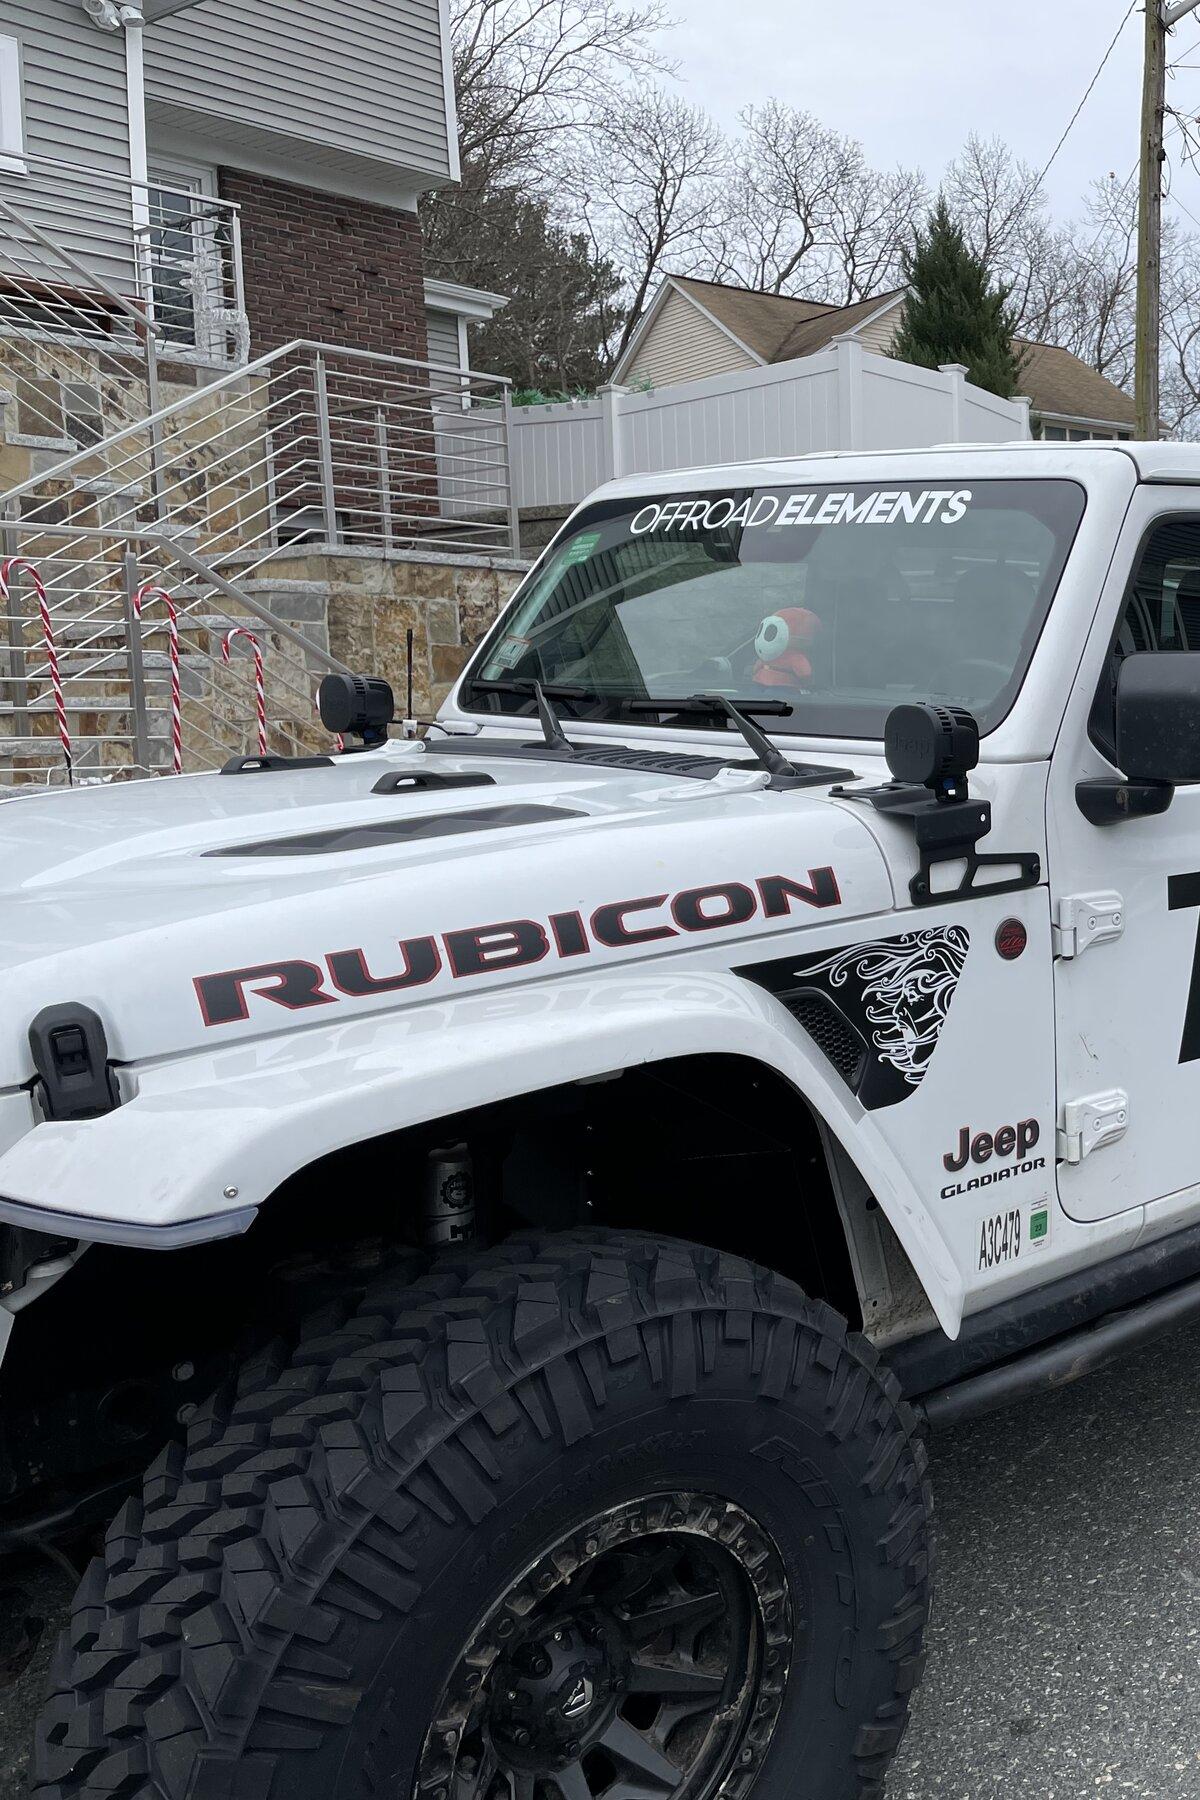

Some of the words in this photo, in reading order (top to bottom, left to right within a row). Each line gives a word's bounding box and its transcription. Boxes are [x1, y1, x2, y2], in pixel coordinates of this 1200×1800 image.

[192, 866, 842, 1028] RUBICON
[943, 1117, 1040, 1172] Jeep
[940, 1157, 1046, 1200] GLADIATOR
[979, 1209, 1020, 1270] A3C479
